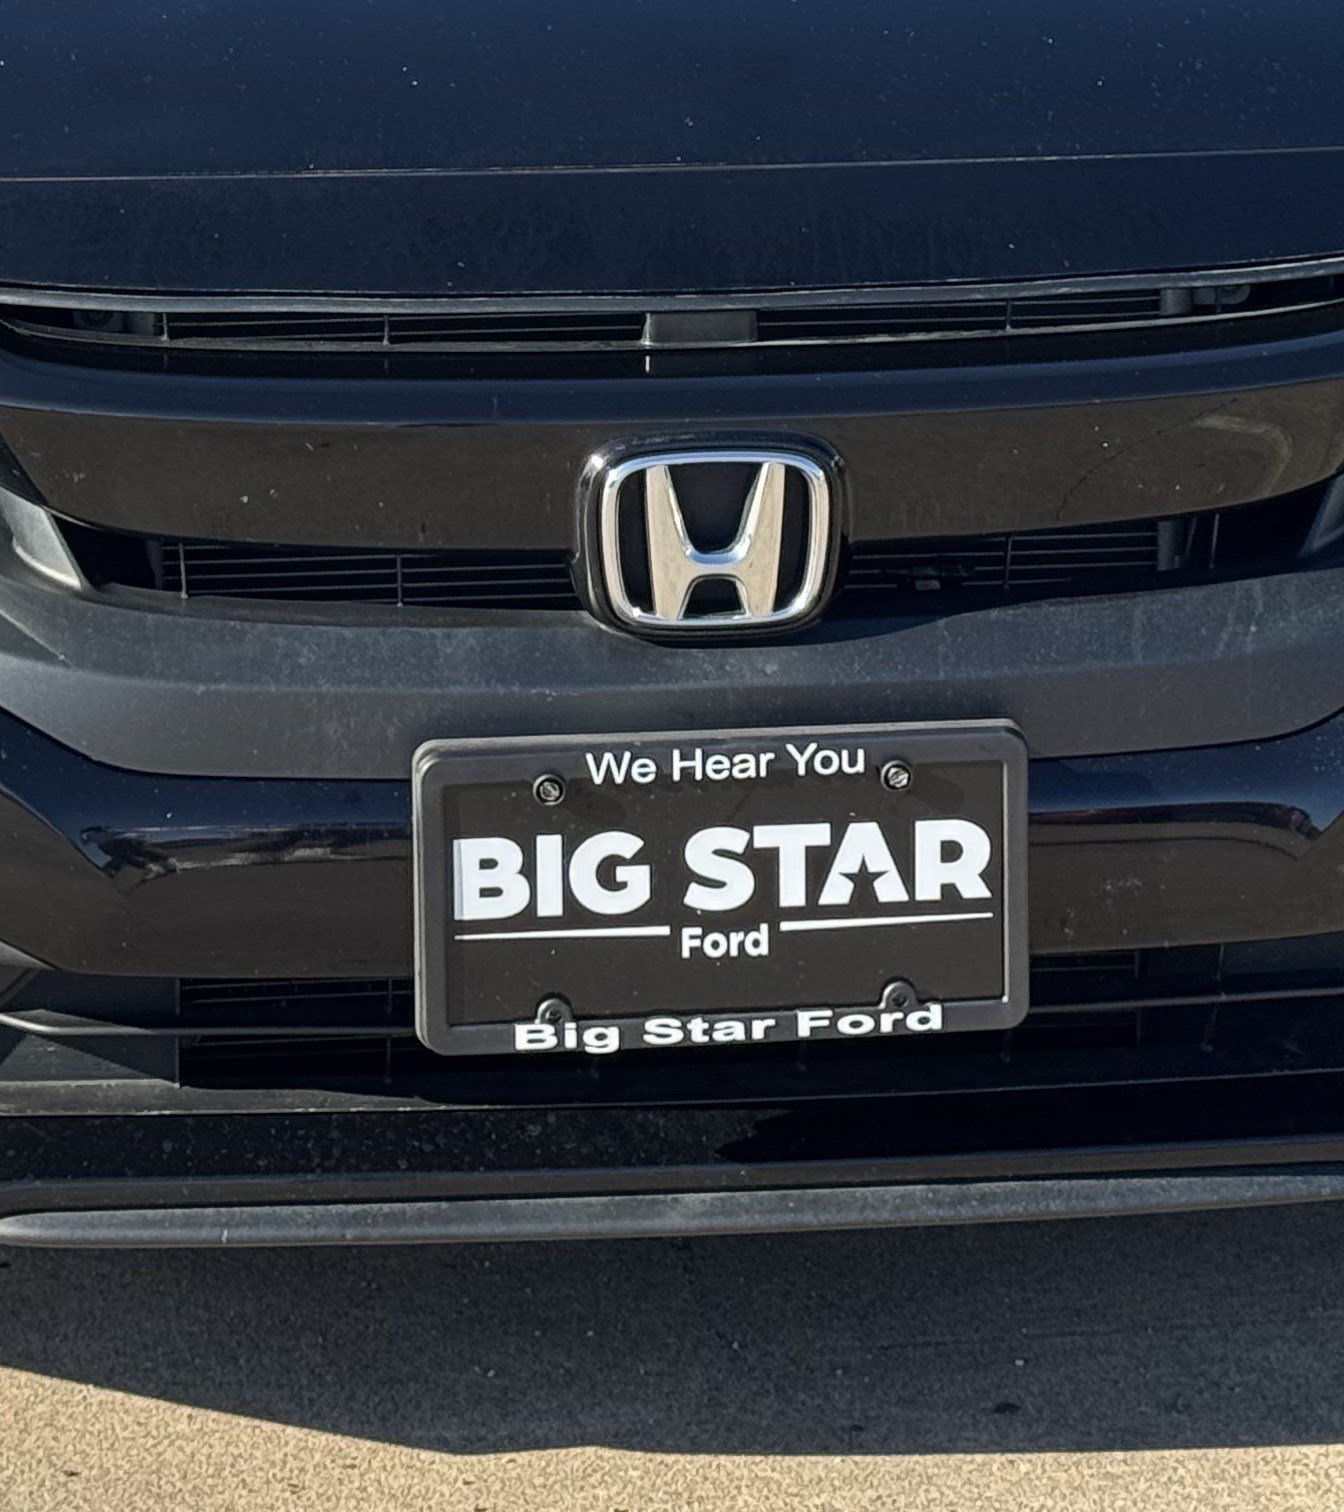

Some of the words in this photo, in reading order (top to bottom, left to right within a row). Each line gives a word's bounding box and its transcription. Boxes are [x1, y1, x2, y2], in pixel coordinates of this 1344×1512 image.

[585, 750, 656, 786] We
[672, 747, 776, 782] Hear
[785, 742, 866, 777] You
[453, 830, 651, 920] BIG
[682, 819, 993, 912] STAR
[680, 922, 770, 960] Ford
[513, 1022, 621, 1054] Big
[642, 1015, 777, 1045] Star
[796, 1003, 943, 1039] Ford
